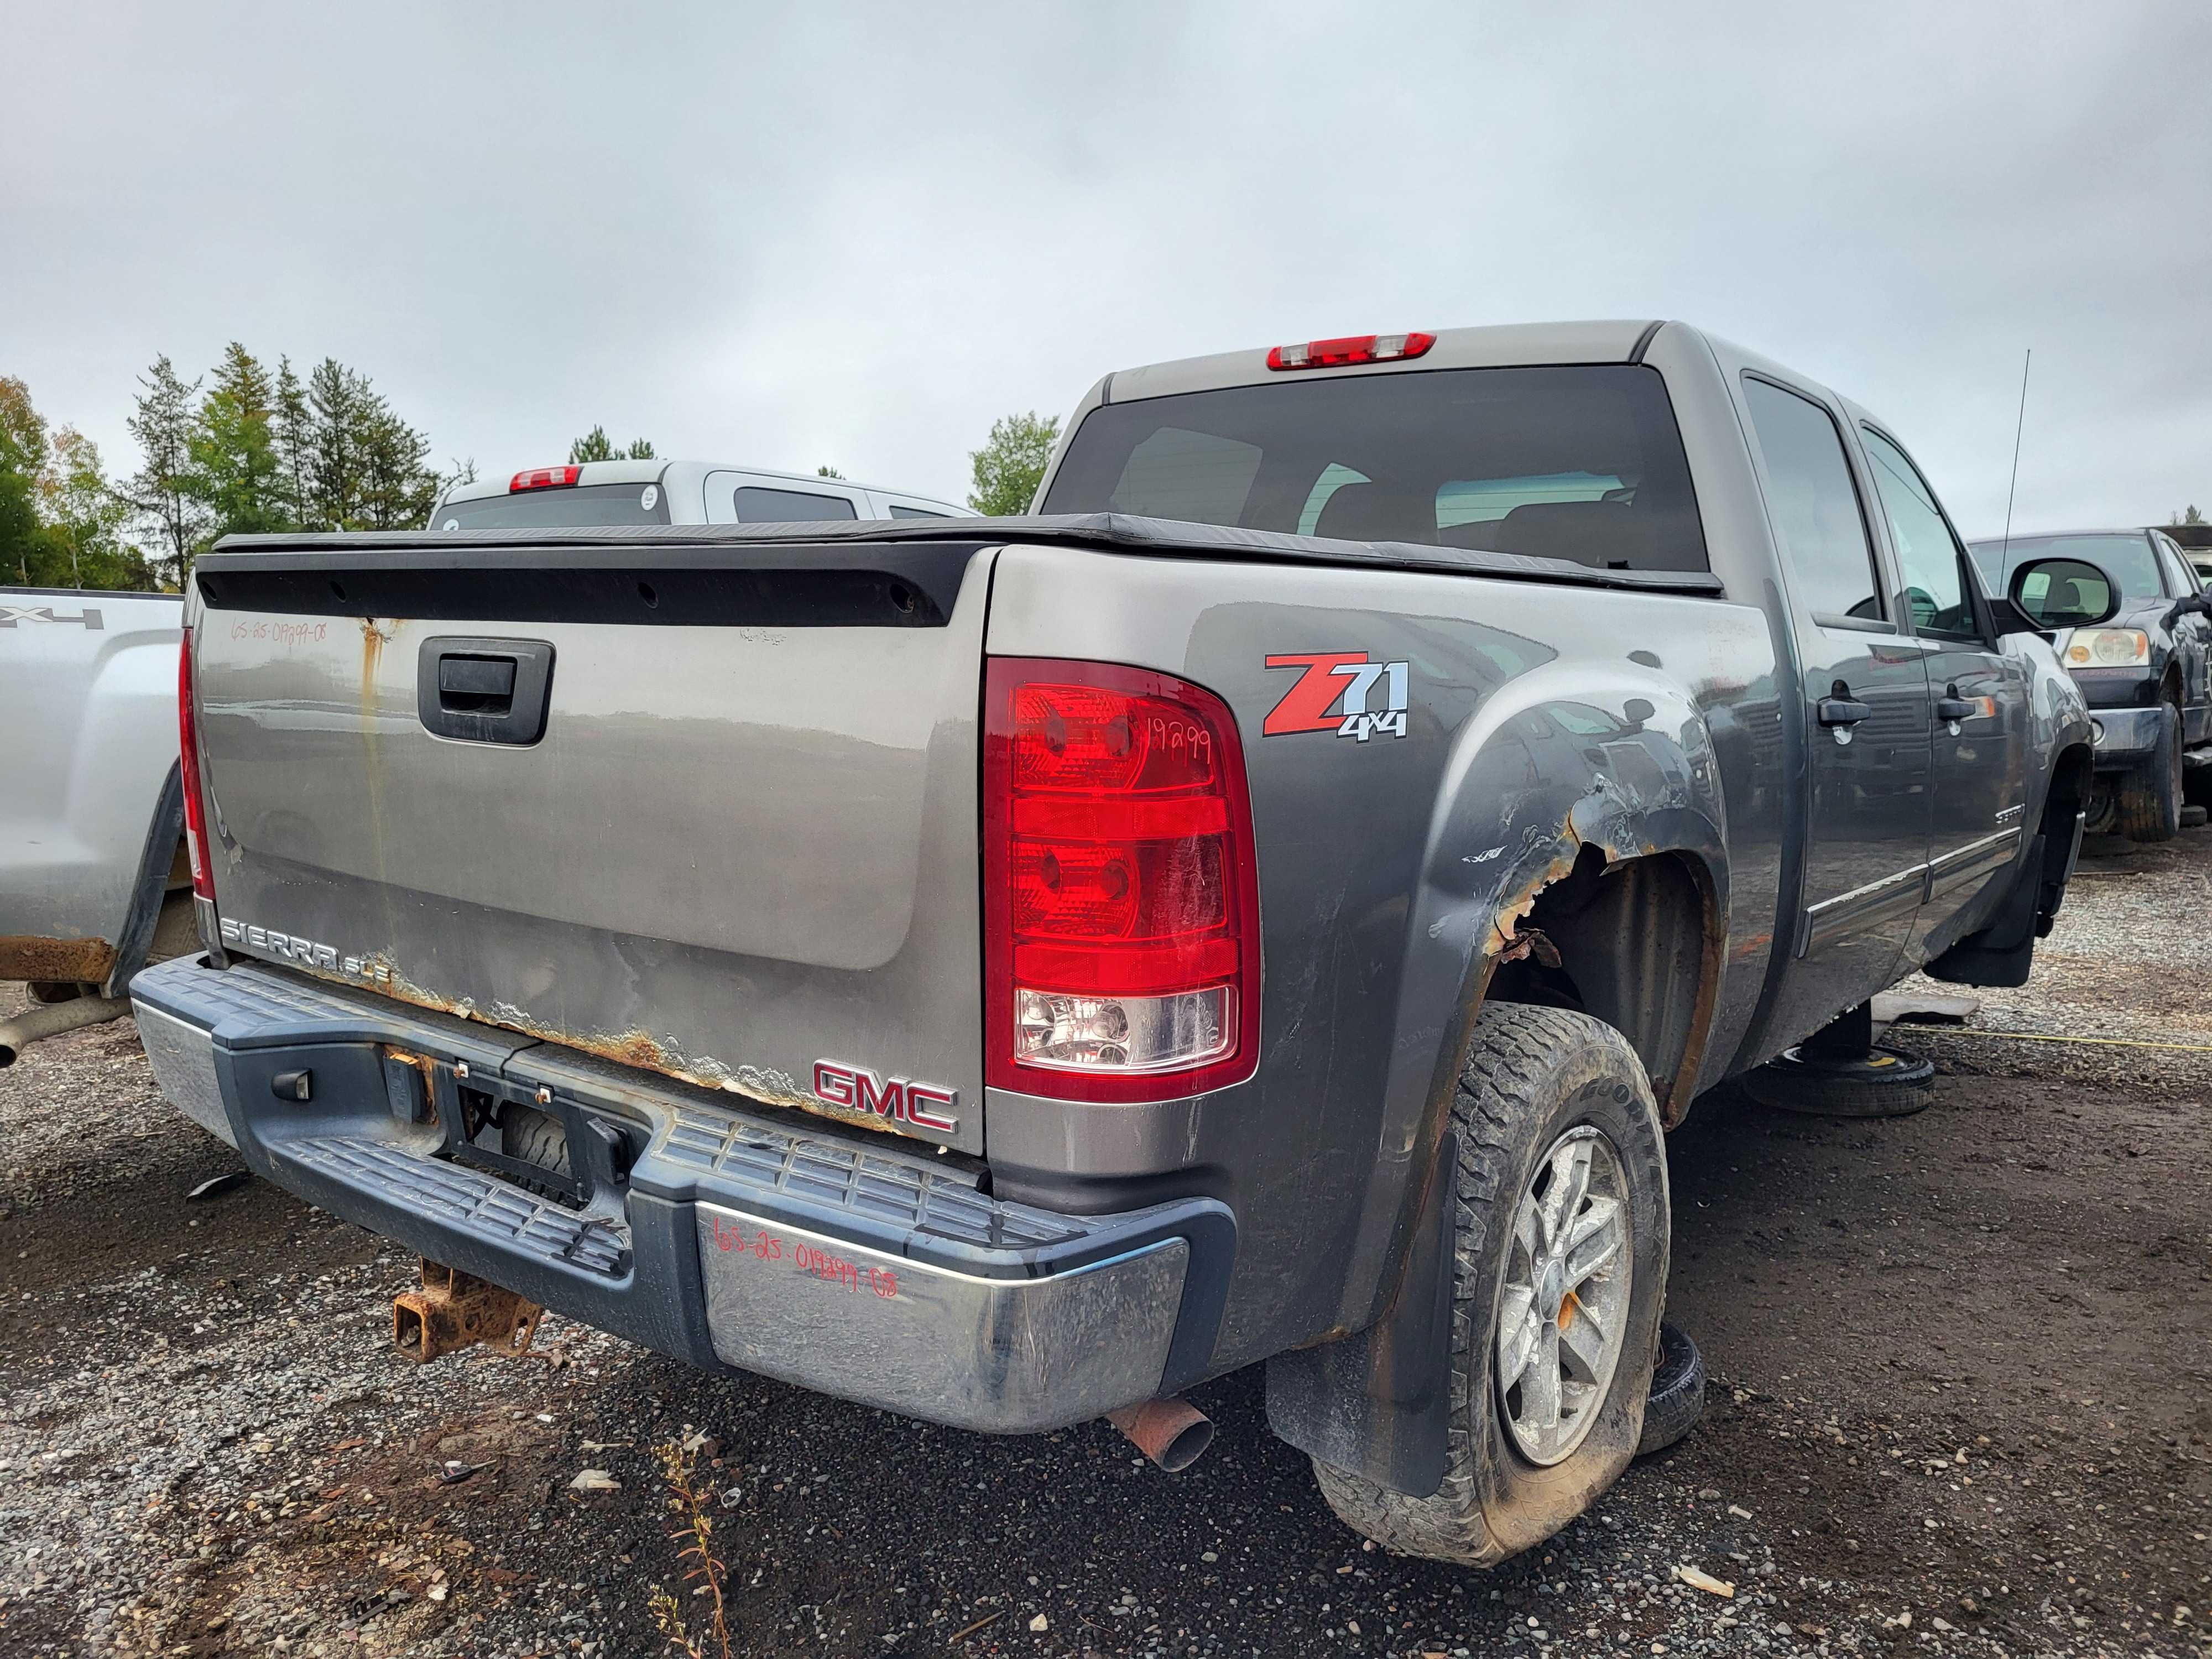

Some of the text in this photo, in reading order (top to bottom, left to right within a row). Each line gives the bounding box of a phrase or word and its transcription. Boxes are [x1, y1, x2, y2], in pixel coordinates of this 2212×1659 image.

[1262, 651, 1409, 738] Z71
[1148, 717, 1211, 765] 19299
[221, 917, 391, 983] SIERRA SLE
[813, 1057, 960, 1134] GMC
